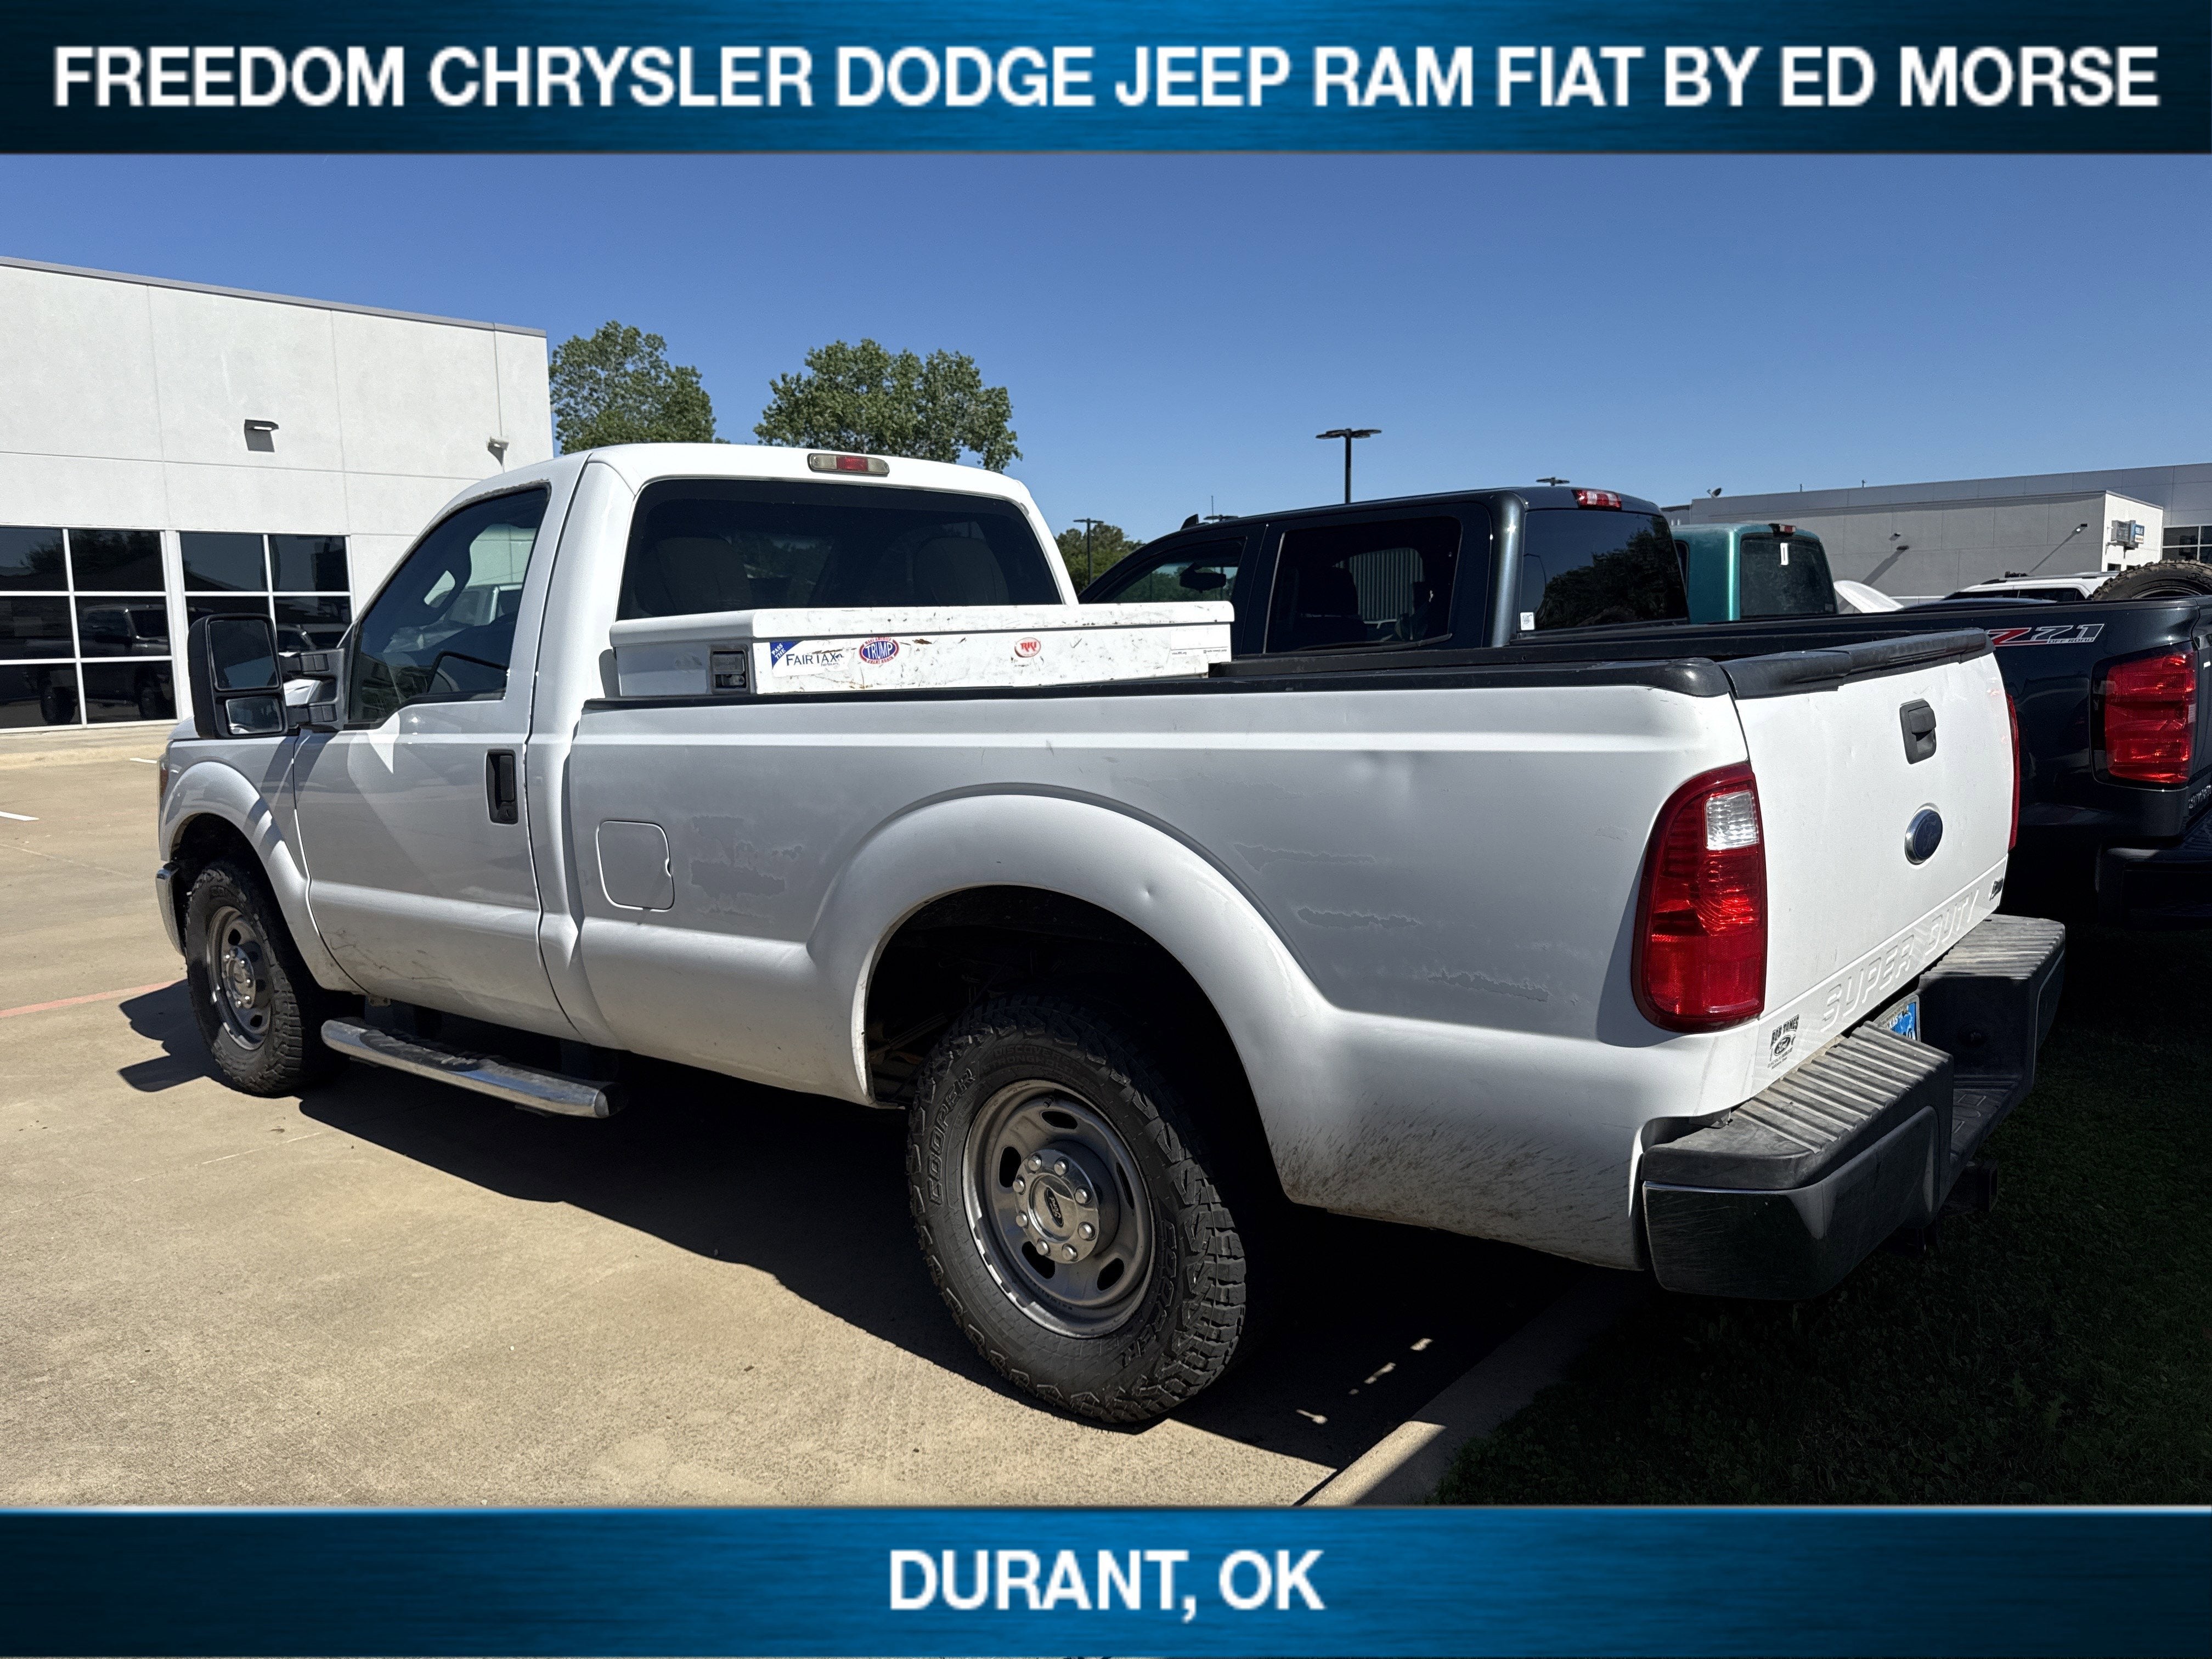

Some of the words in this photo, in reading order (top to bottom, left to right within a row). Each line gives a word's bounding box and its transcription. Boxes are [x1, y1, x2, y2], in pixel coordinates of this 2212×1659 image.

[1984, 623, 2106, 647] Z71
[771, 643, 783, 656] PASS
[775, 647, 786, 659] THE
[865, 641, 893, 659] TRUMP
[1820, 934, 1915, 1032] SUPER
[1925, 887, 1979, 956] DUTY
[928, 1067, 975, 1206] COOPER
[1048, 1196, 1062, 1218] Ford
[1119, 1218, 1177, 1369] COOPER
